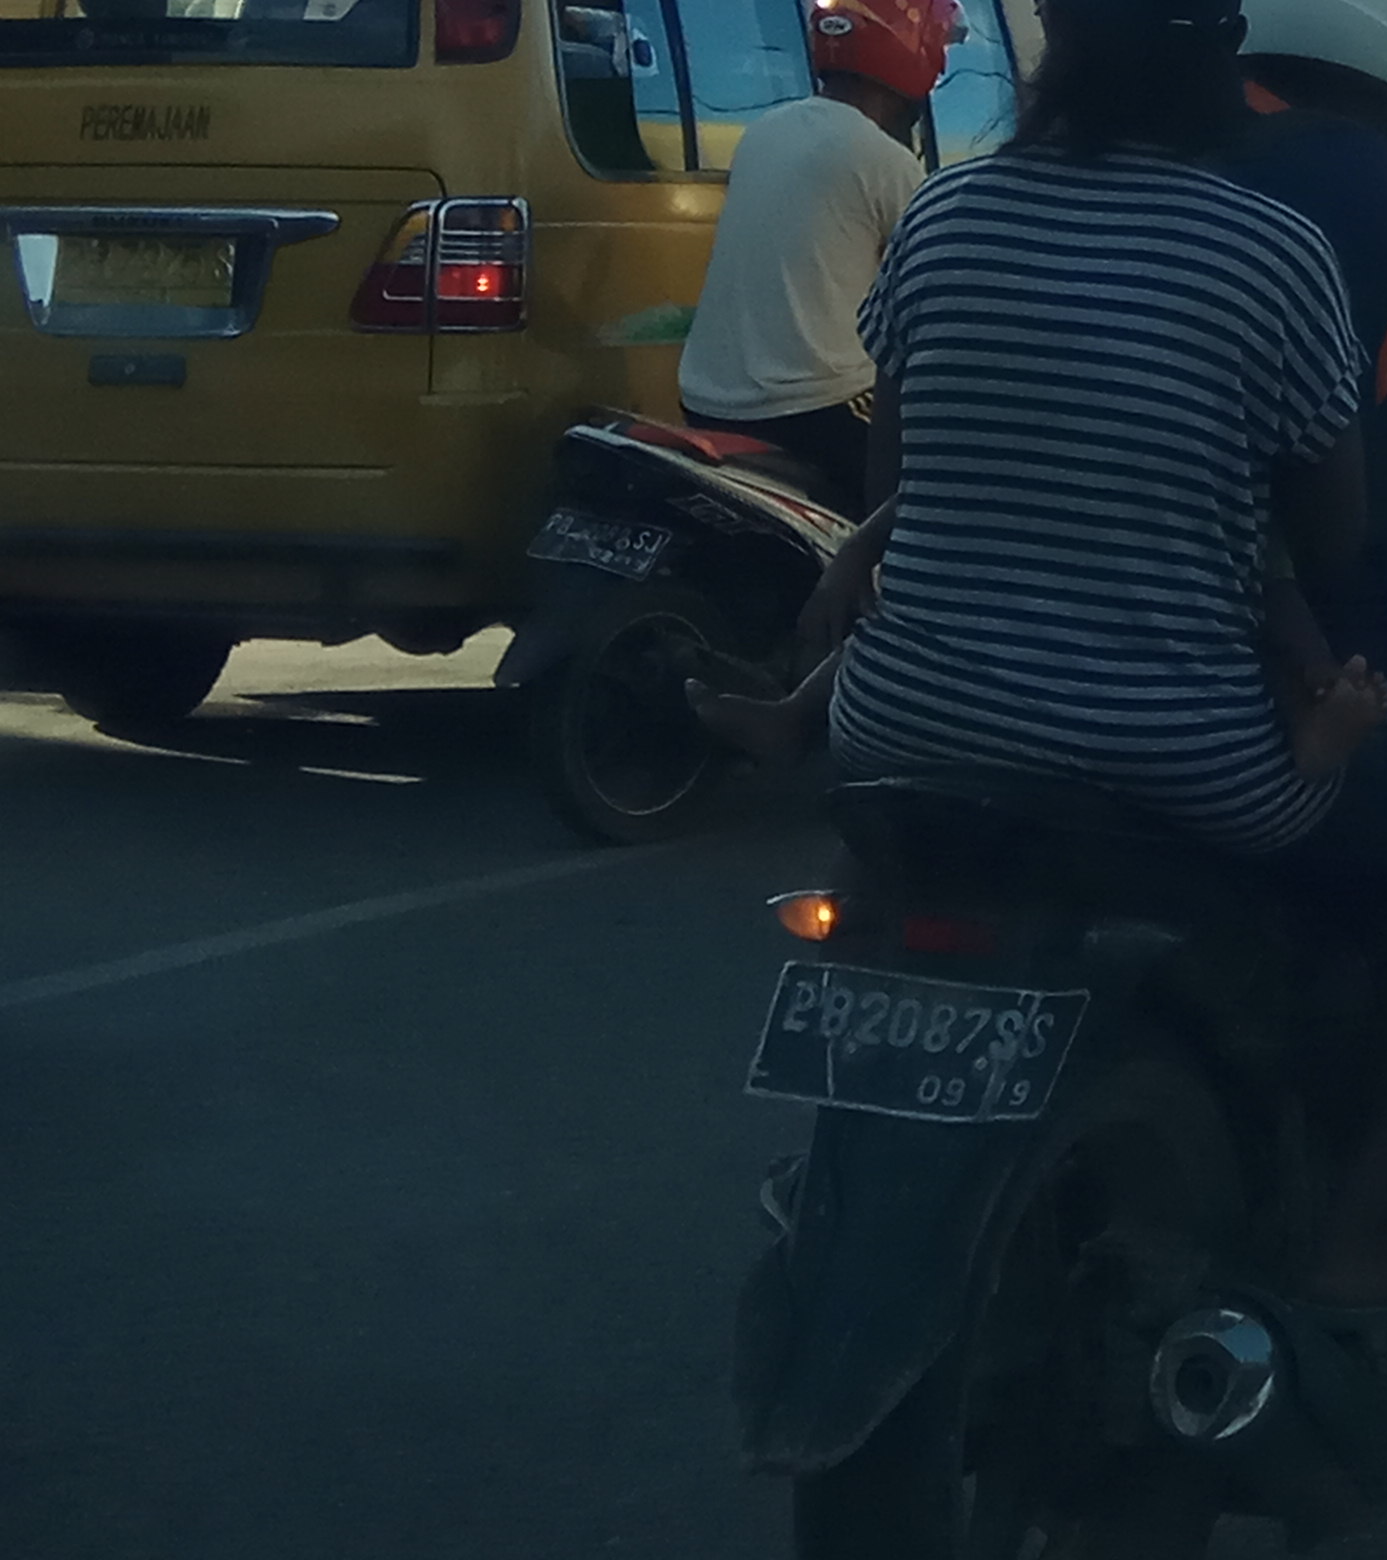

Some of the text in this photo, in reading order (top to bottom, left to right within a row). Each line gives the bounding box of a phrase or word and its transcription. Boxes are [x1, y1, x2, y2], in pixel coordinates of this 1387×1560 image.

[81, 104, 211, 140] PEREMAJAAN
[852, 992, 992, 1054] 2087
[917, 1074, 966, 1106] 09
